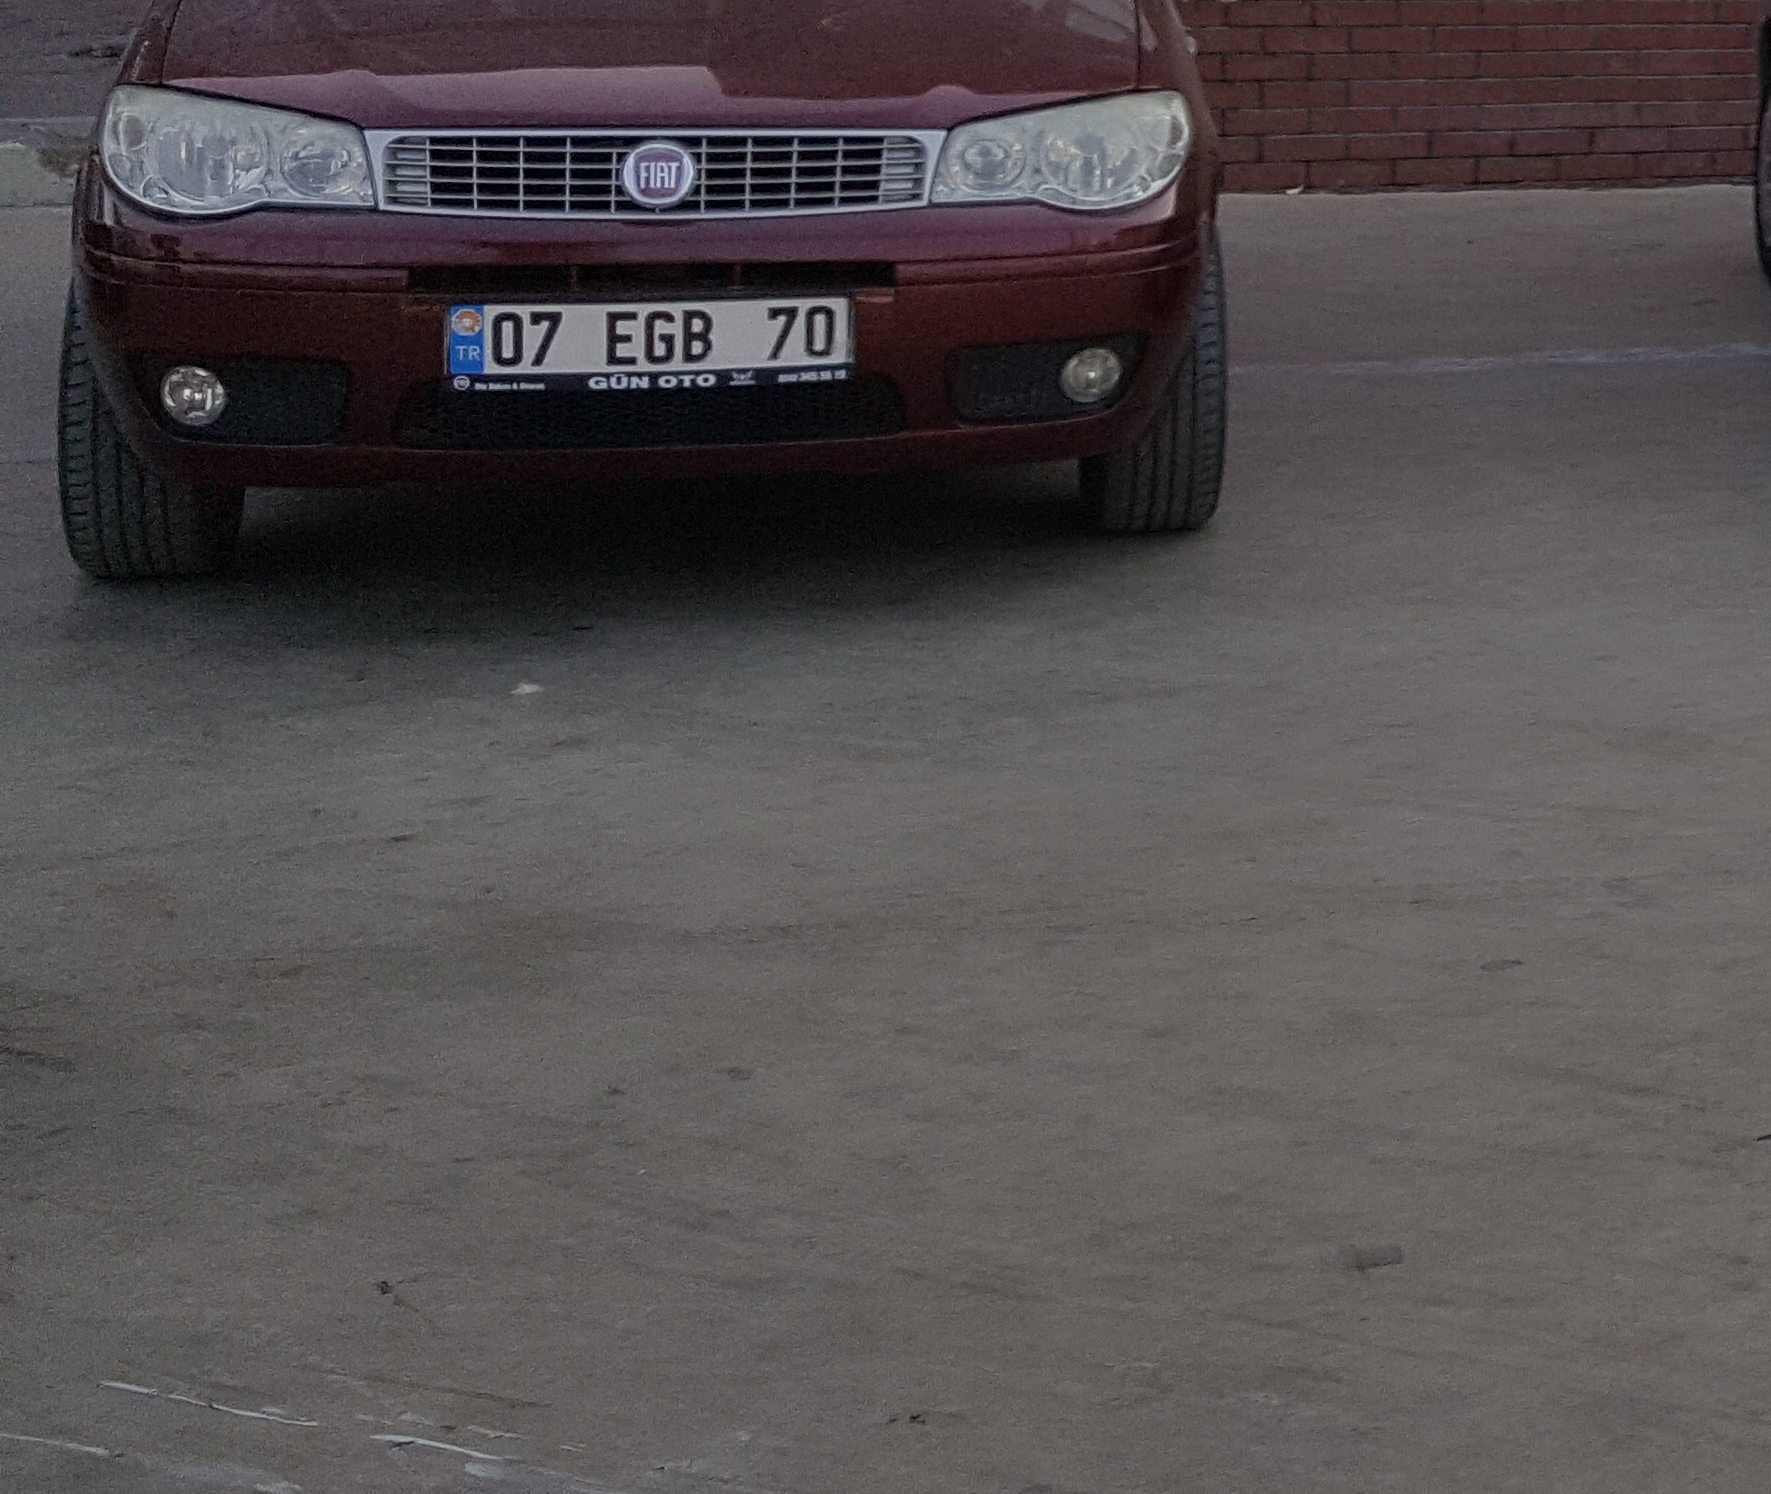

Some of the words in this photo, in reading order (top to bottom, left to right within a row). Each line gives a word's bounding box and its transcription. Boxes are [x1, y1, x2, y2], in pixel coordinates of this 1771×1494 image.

[640, 161, 681, 189] FIAT
[490, 310, 564, 367] 07
[604, 307, 715, 367] EGB
[766, 305, 836, 362] 70
[455, 345, 481, 362] TR
[588, 374, 651, 391] GÜN
[657, 373, 718, 389] OTO
